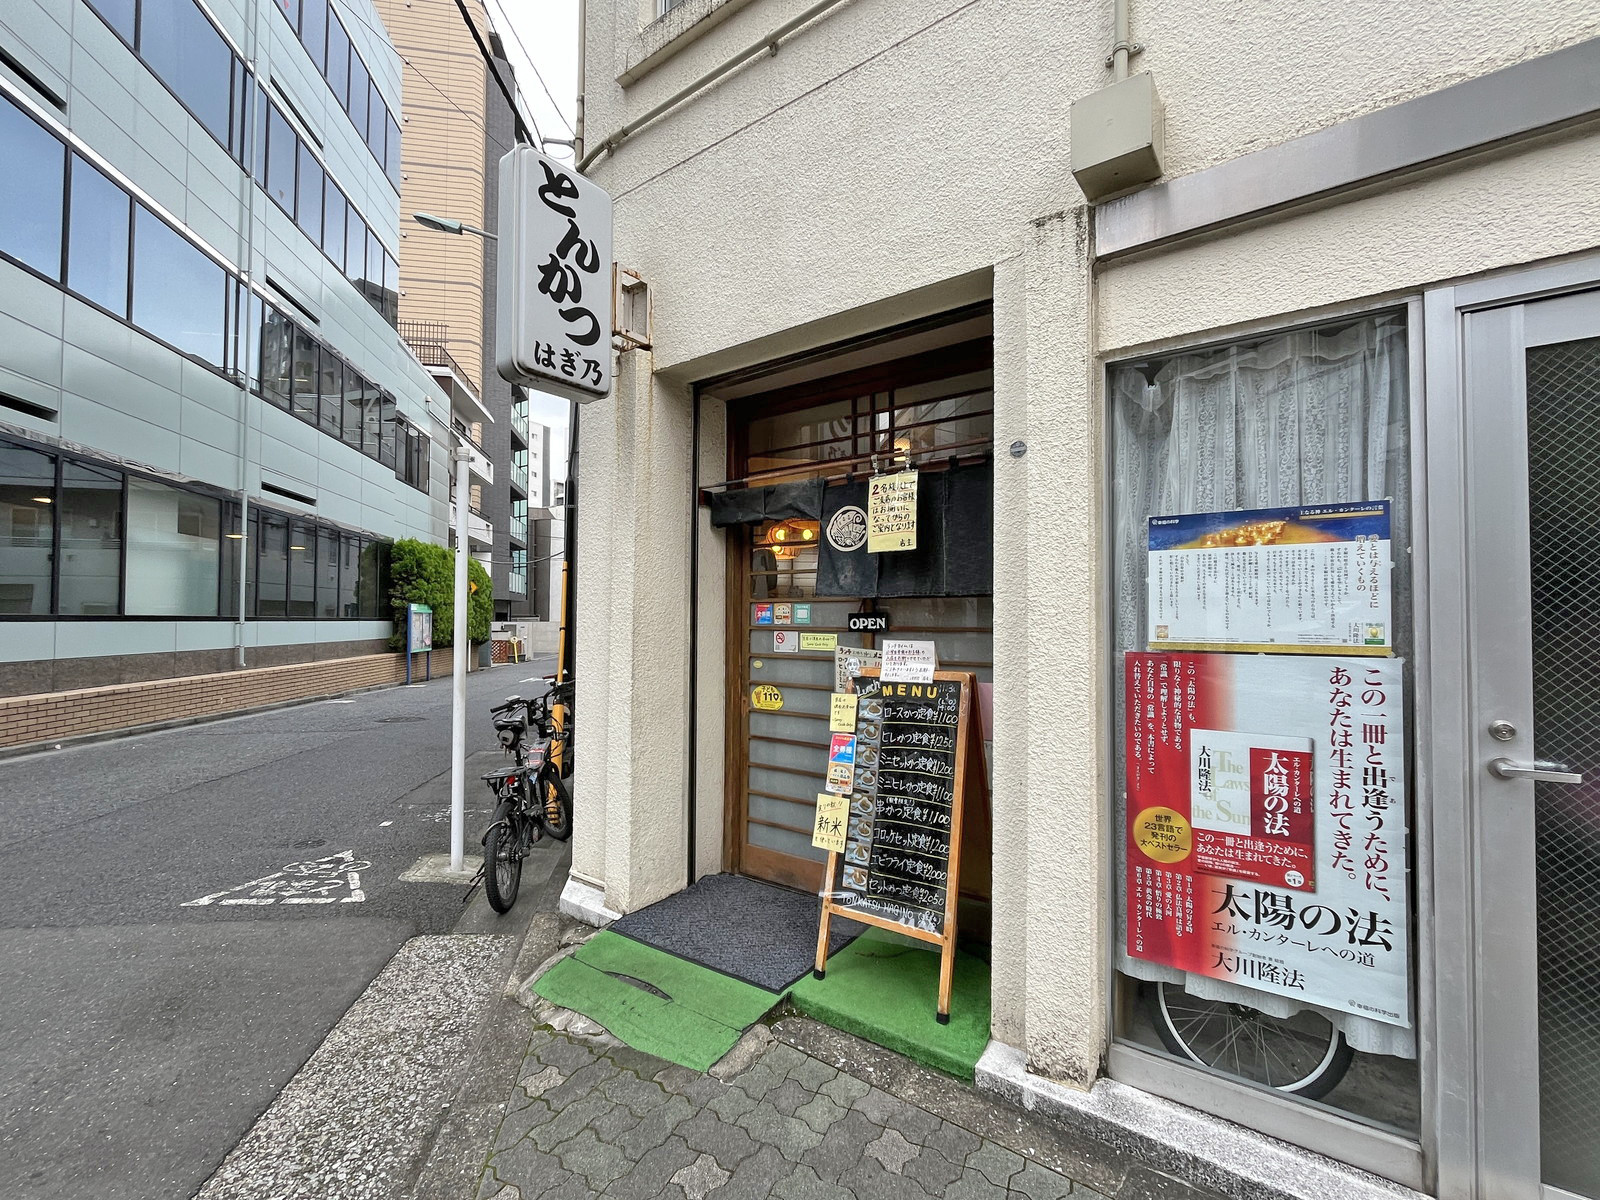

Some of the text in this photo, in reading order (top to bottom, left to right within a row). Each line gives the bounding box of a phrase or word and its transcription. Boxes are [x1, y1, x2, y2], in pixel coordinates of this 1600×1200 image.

[538, 160, 600, 346] とんかつ
[533, 340, 603, 386] はぎ乃
[1356, 535, 1366, 592] 増えていくもの
[1369, 535, 1380, 608] 愛とは与えるほどに
[849, 617, 886, 630] OPEN
[856, 680, 881, 697] Lunch
[883, 684, 937, 699] MENU
[1198, 745, 1212, 793] 大川隆法
[1213, 750, 1244, 775] The
[1329, 666, 1357, 880] あなたは生まれてきた。
[1208, 765, 1250, 792] Laws
[1293, 757, 1302, 814] エル・カンターレへの道
[1361, 668, 1391, 902] この一冊と出逢うために、
[1263, 752, 1290, 837] 太陽の法
[817, 815, 842, 837] 新米
[1154, 814, 1172, 823] 世界
[1193, 800, 1250, 826] the Sun
[1144, 822, 1183, 834] 23言語で
[1151, 831, 1177, 842] 発刊の
[1140, 839, 1188, 852] 大ベストセラー
[1196, 843, 1297, 869] あなたは生まれてきた。
[1197, 832, 1309, 859] この一冊と出逢うために、
[883, 902, 914, 919] HAGINO
[1211, 884, 1394, 952] 太陽の法
[1211, 921, 1375, 968] エル・カンターレへの道
[1211, 951, 1305, 991] 大川隆法
[1356, 1002, 1400, 1020] 幸福の科学出版
